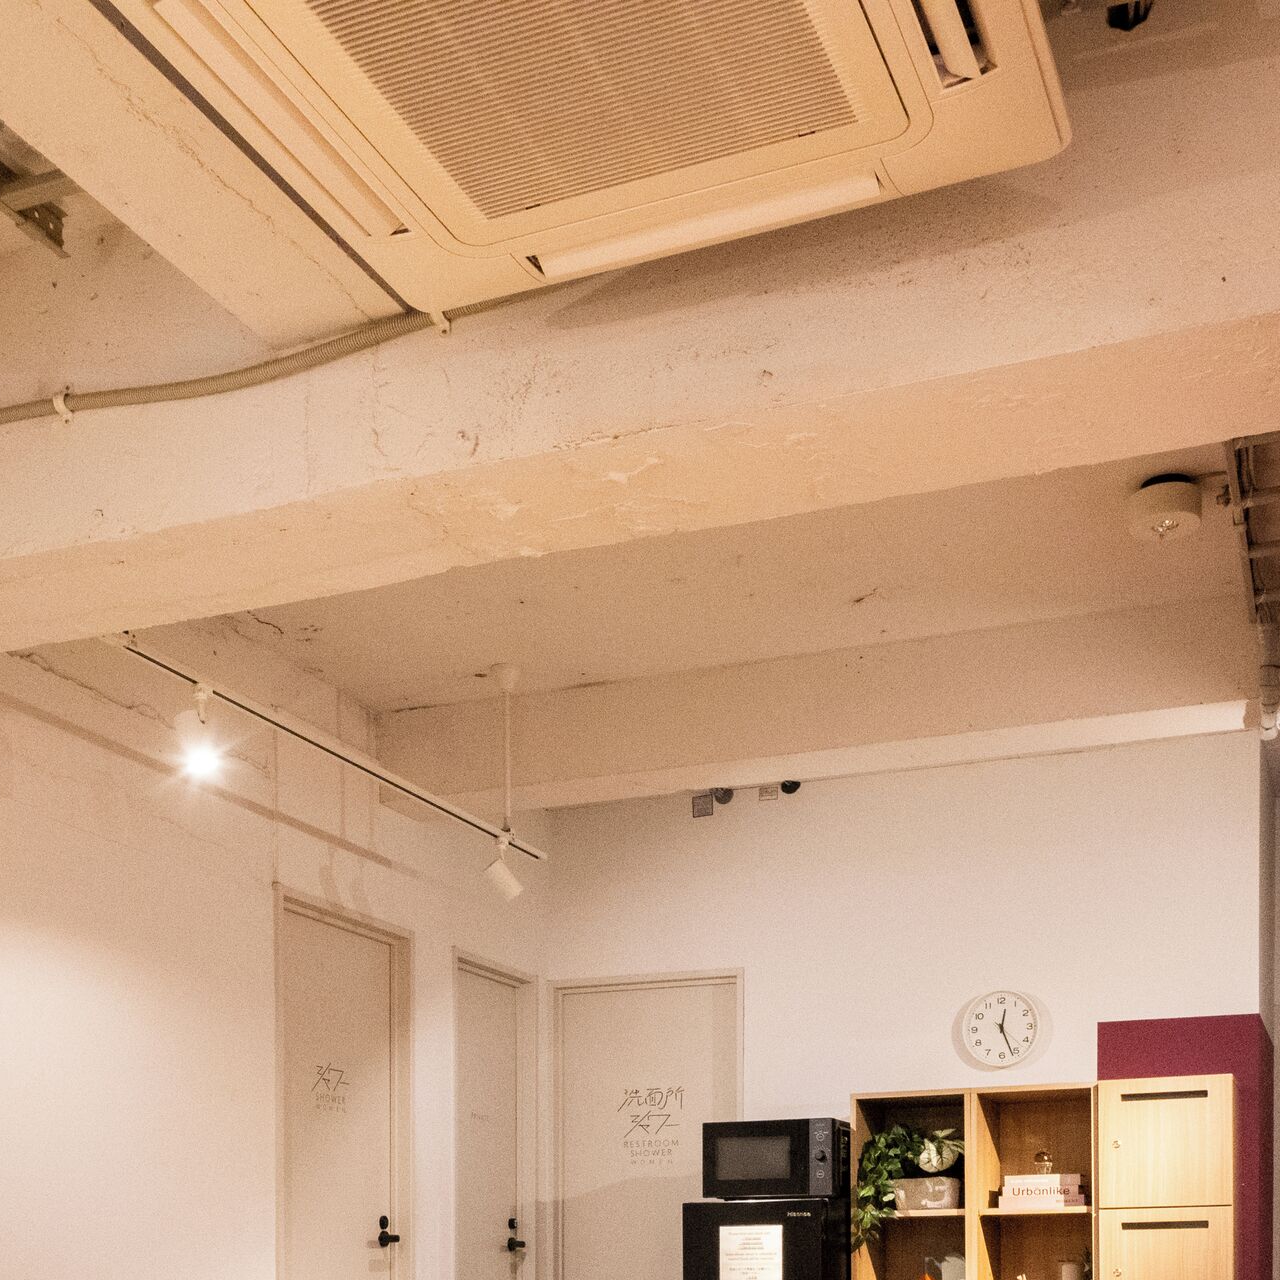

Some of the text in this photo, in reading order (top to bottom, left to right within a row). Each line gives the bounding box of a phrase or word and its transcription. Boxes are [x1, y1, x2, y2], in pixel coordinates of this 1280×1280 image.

[975, 1012, 984, 1020] 10
[1022, 1009, 1029, 1017] 2
[971, 1026, 978, 1034] 9
[1026, 1022, 1033, 1030] 3
[975, 1039, 982, 1047] 8
[1013, 1047, 1020, 1055] 5
[999, 1052, 1006, 1060] 6
[315, 1091, 346, 1105] SHOWER
[617, 1086, 685, 1112] 洗面所
[623, 1139, 679, 1148] RESTROOM
[630, 1148, 672, 1157] SHOWER
[1012, 1187, 1070, 1197] Urbanlike
